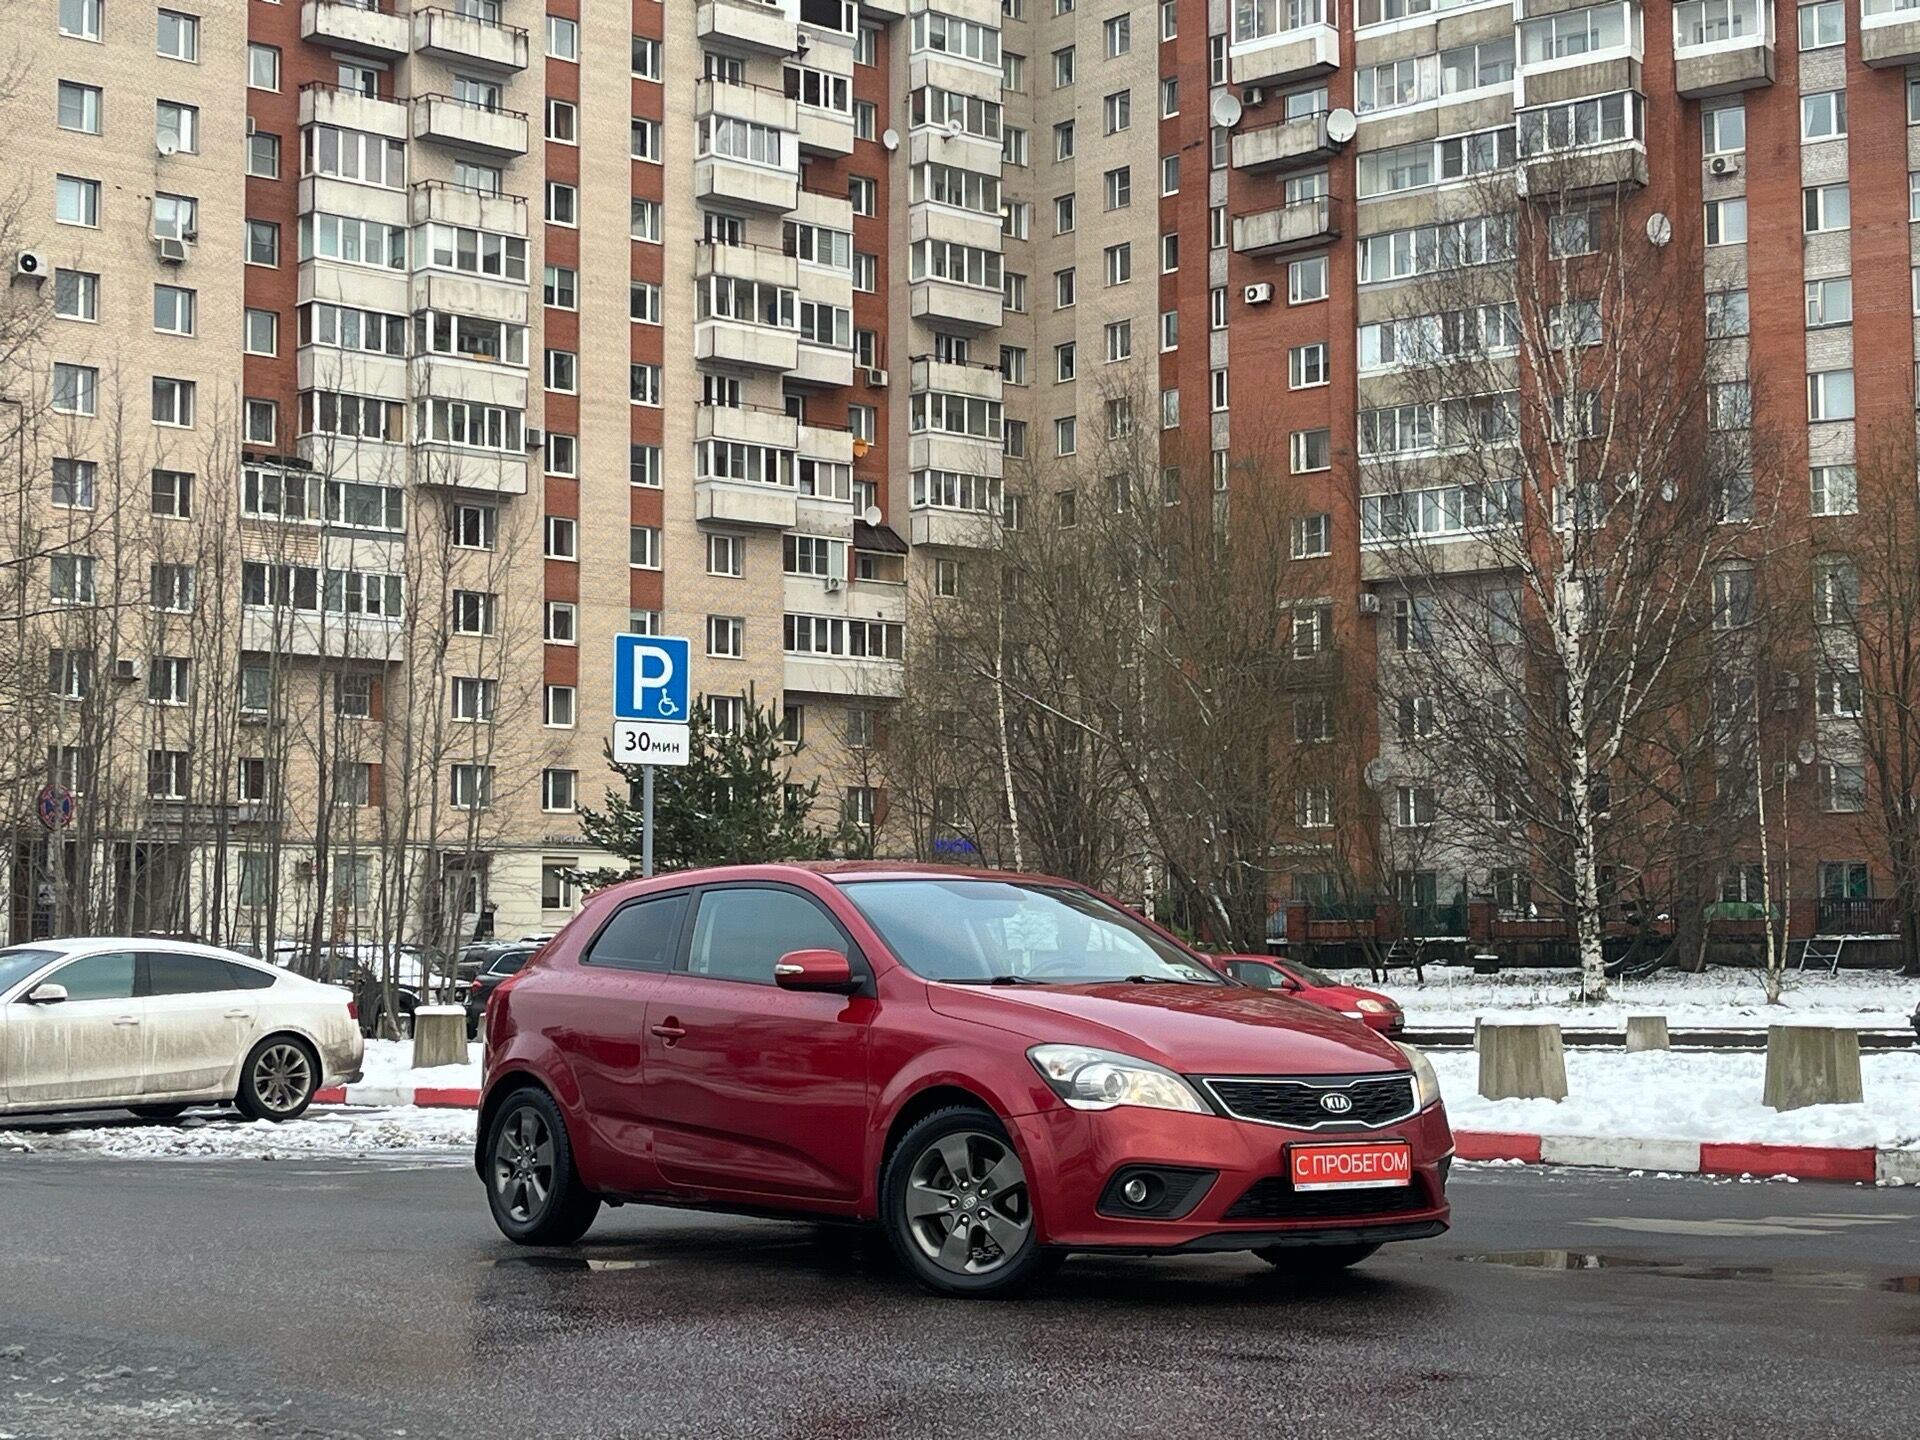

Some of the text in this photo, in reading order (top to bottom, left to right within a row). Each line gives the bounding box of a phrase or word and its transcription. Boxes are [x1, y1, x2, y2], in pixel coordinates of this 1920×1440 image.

[633, 645, 673, 710] P
[1325, 1097, 1348, 1109] KIA
[1296, 1152, 1408, 1175] С ПРОБЕГОМ
